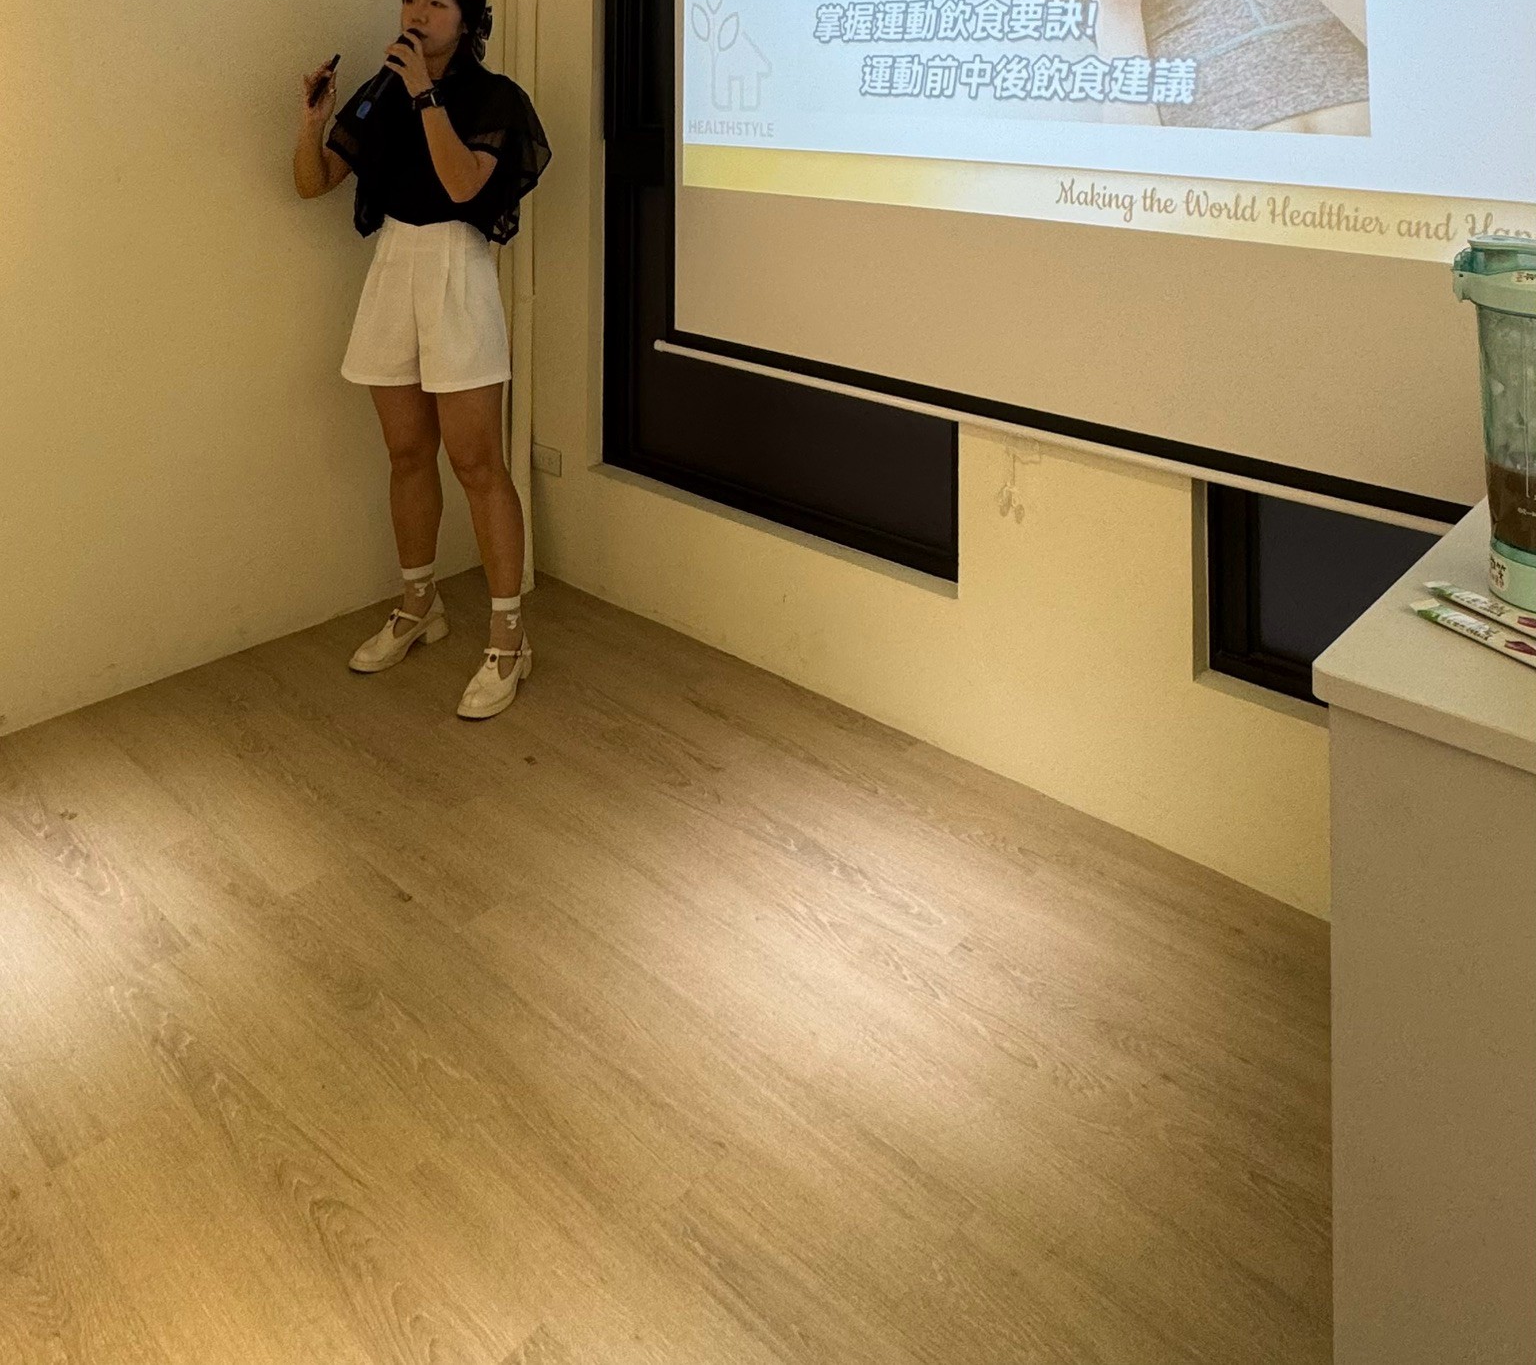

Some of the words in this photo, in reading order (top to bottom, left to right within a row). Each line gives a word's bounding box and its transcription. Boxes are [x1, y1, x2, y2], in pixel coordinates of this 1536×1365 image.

[860, 54, 1197, 104] 運動前中後飲食建議
[688, 119, 774, 138] HEALTHSTYLE
[1055, 178, 1137, 223] Making
[1142, 187, 1177, 214] the
[1184, 189, 1260, 223] World
[1267, 195, 1389, 235] Healthier
[1396, 212, 1456, 242] and
